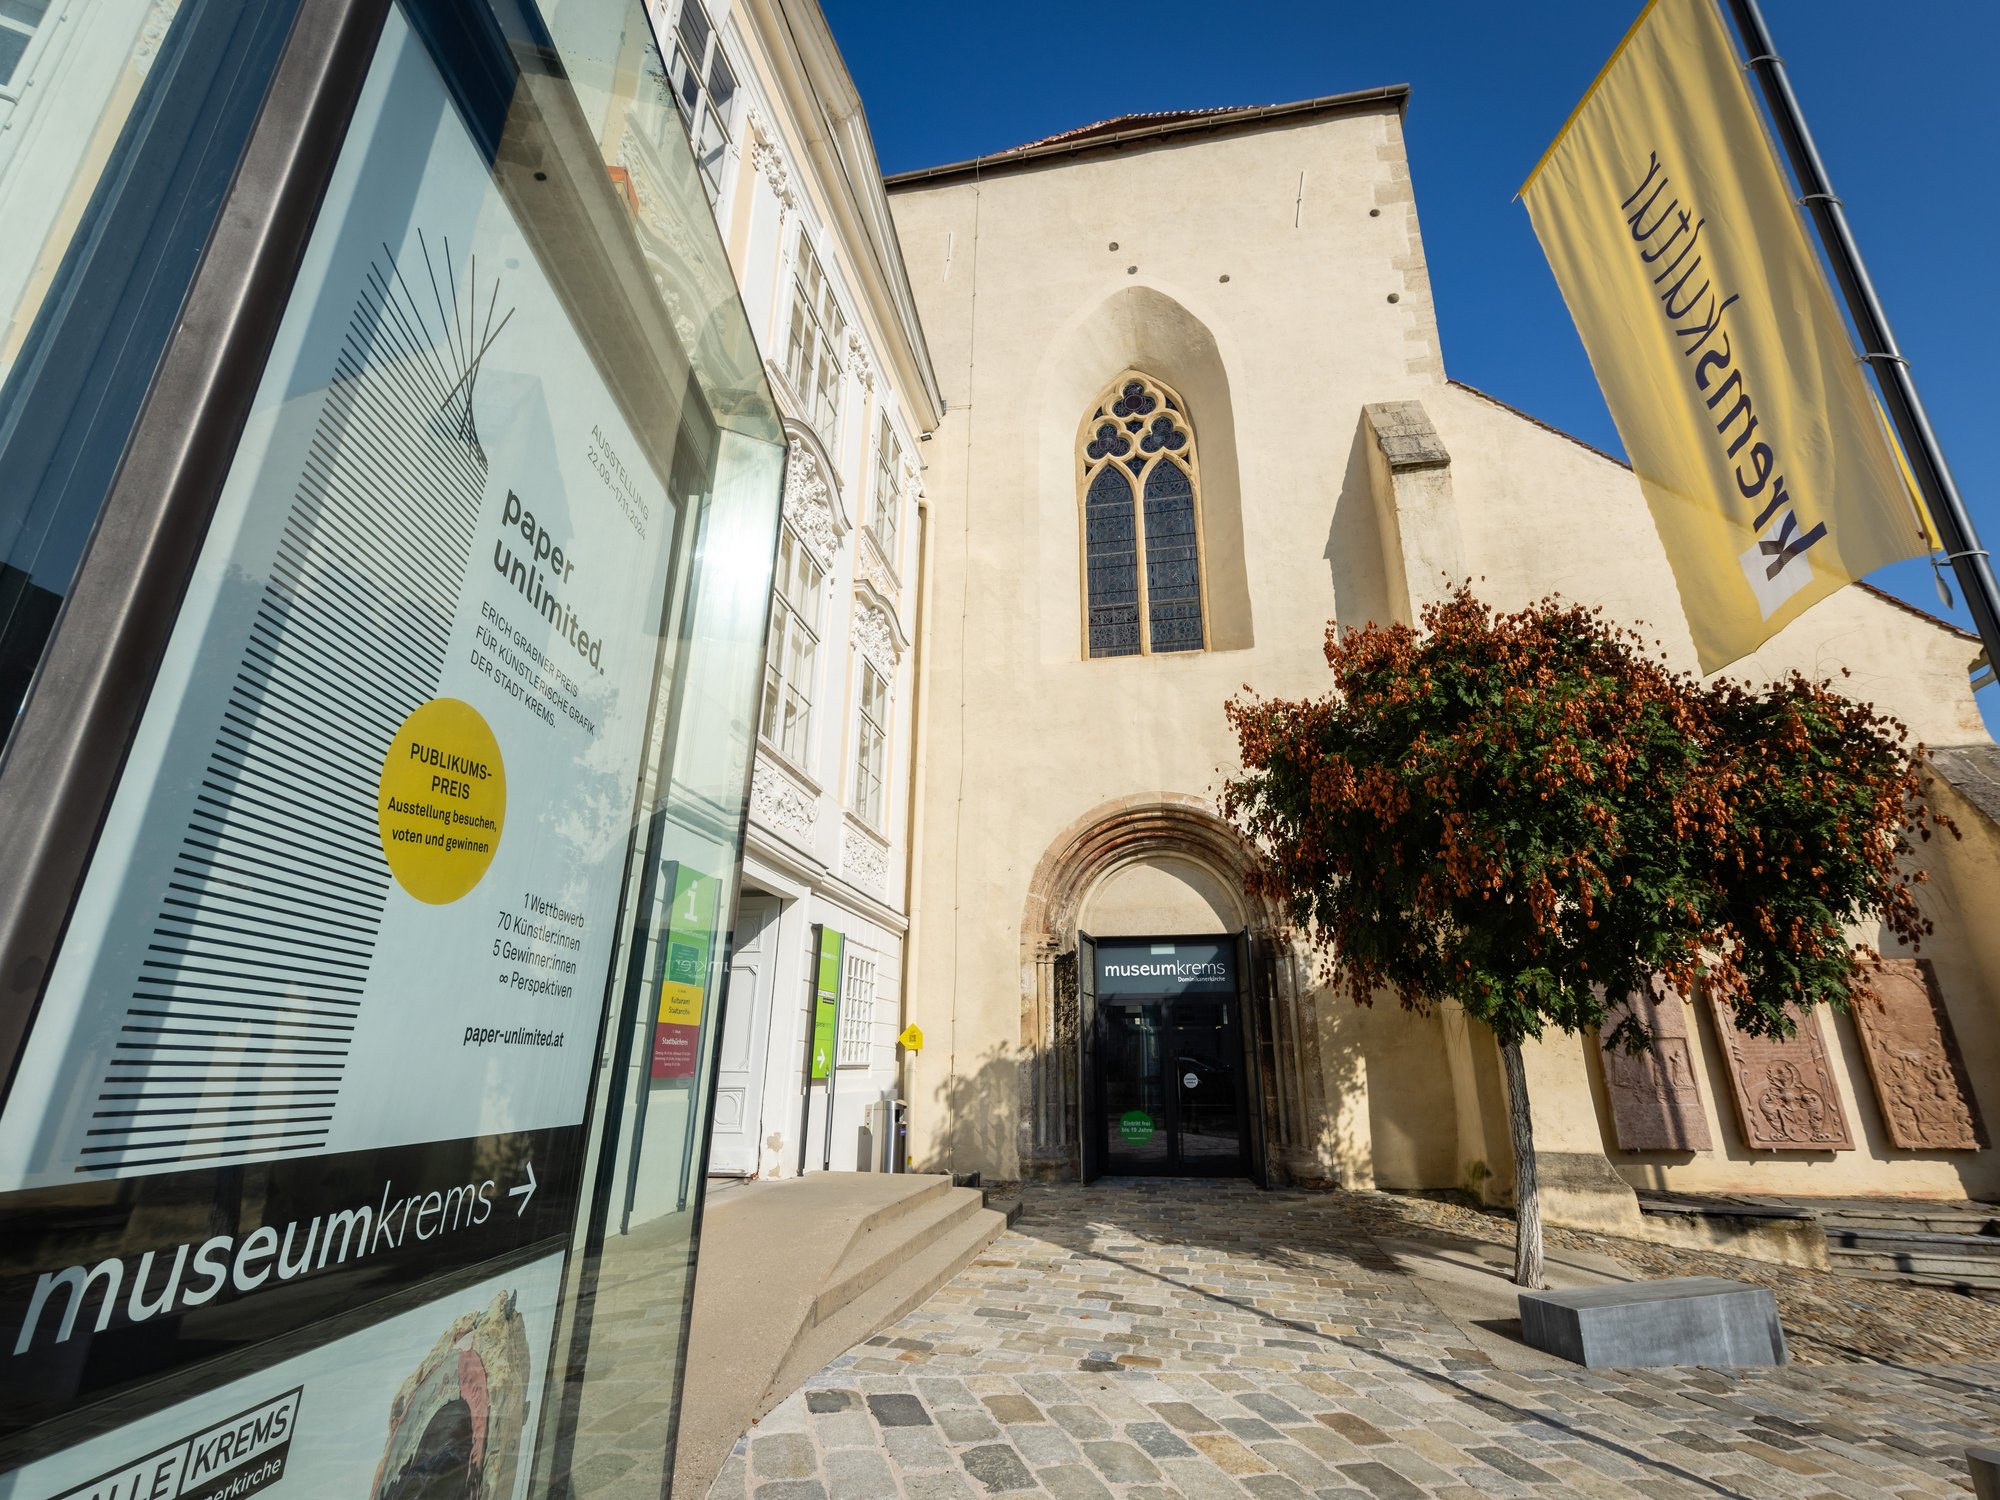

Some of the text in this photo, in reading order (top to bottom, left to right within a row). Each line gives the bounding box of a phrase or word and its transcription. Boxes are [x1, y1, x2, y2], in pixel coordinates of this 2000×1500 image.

[591, 424, 649, 519] AUSSTELLUNG
[502, 488, 574, 584] paper
[494, 539, 604, 676] unlimited.
[481, 601, 578, 697] ERICH GRABNER PREIS
[471, 649, 555, 728] DER STADT KREMS.
[476, 625, 595, 736] FÜR KÜNSTLERISCHE GRAFIK
[410, 742, 492, 780] PUBLIKUMS-
[431, 775, 470, 800] PREIS
[387, 797, 497, 832] Ausstellung besuchen,
[392, 828, 489, 853] voten und gewinnen
[524, 892, 585, 928] 1 Wettbewerb
[497, 911, 581, 951] 70 Künstler:innen
[493, 939, 577, 975] 5 Gewinner:innen
[1105, 959, 1226, 977] museumkrems
[510, 971, 572, 998] Perspektiven
[463, 1026, 564, 1047] paper-unlimited.at
[13, 1180, 495, 1355] museumkrems
[191, 1405, 290, 1481] KREMS
